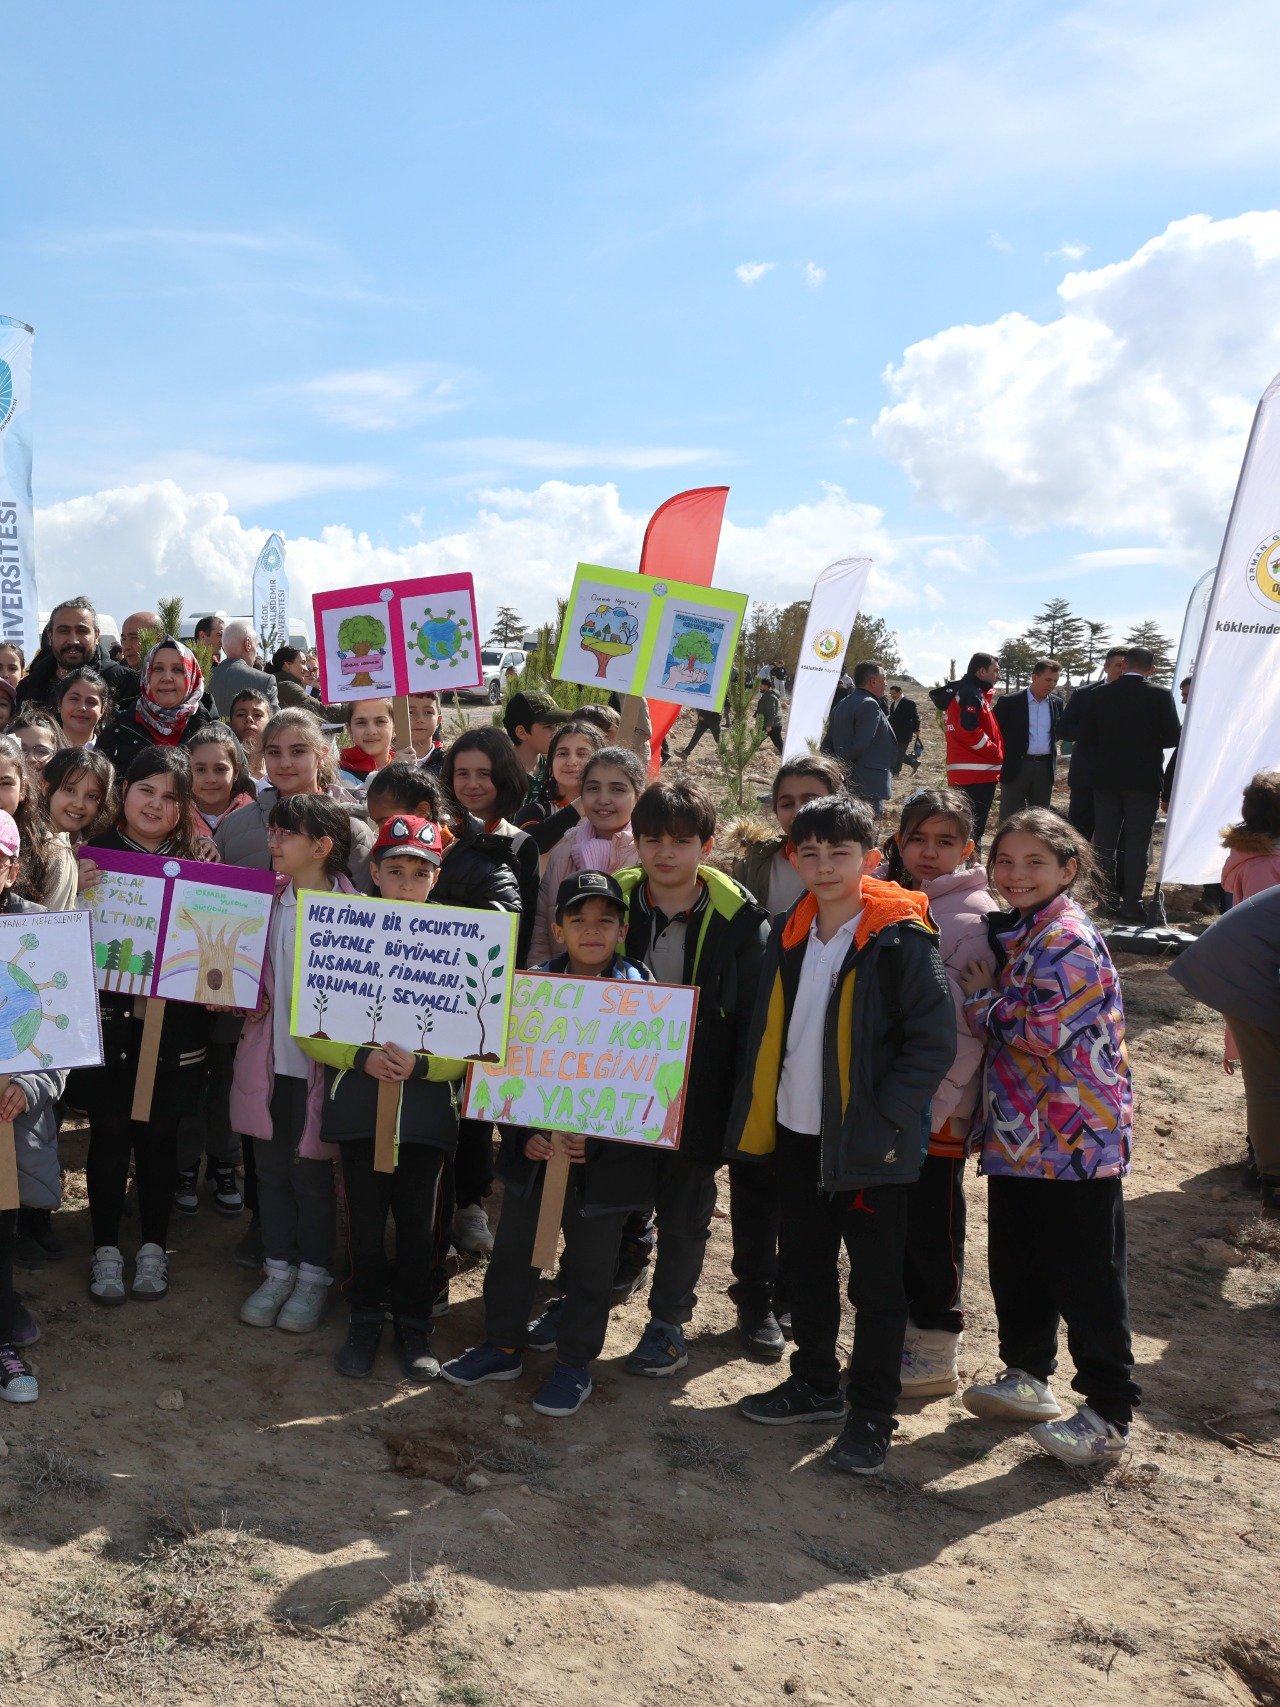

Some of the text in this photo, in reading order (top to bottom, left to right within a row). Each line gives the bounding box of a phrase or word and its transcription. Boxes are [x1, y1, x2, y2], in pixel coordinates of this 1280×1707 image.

[308, 904, 486, 941] HER FİDAN BİR ÇOCUKTUR,
[309, 930, 461, 966] GÜVENLE BÜYÜMELİ.
[306, 973, 387, 1002] KORUMALI,
[308, 950, 465, 991] İNSANLAR, FİDANLARI,
[598, 984, 673, 1016] SEV
[608, 1016, 687, 1051] KORU
